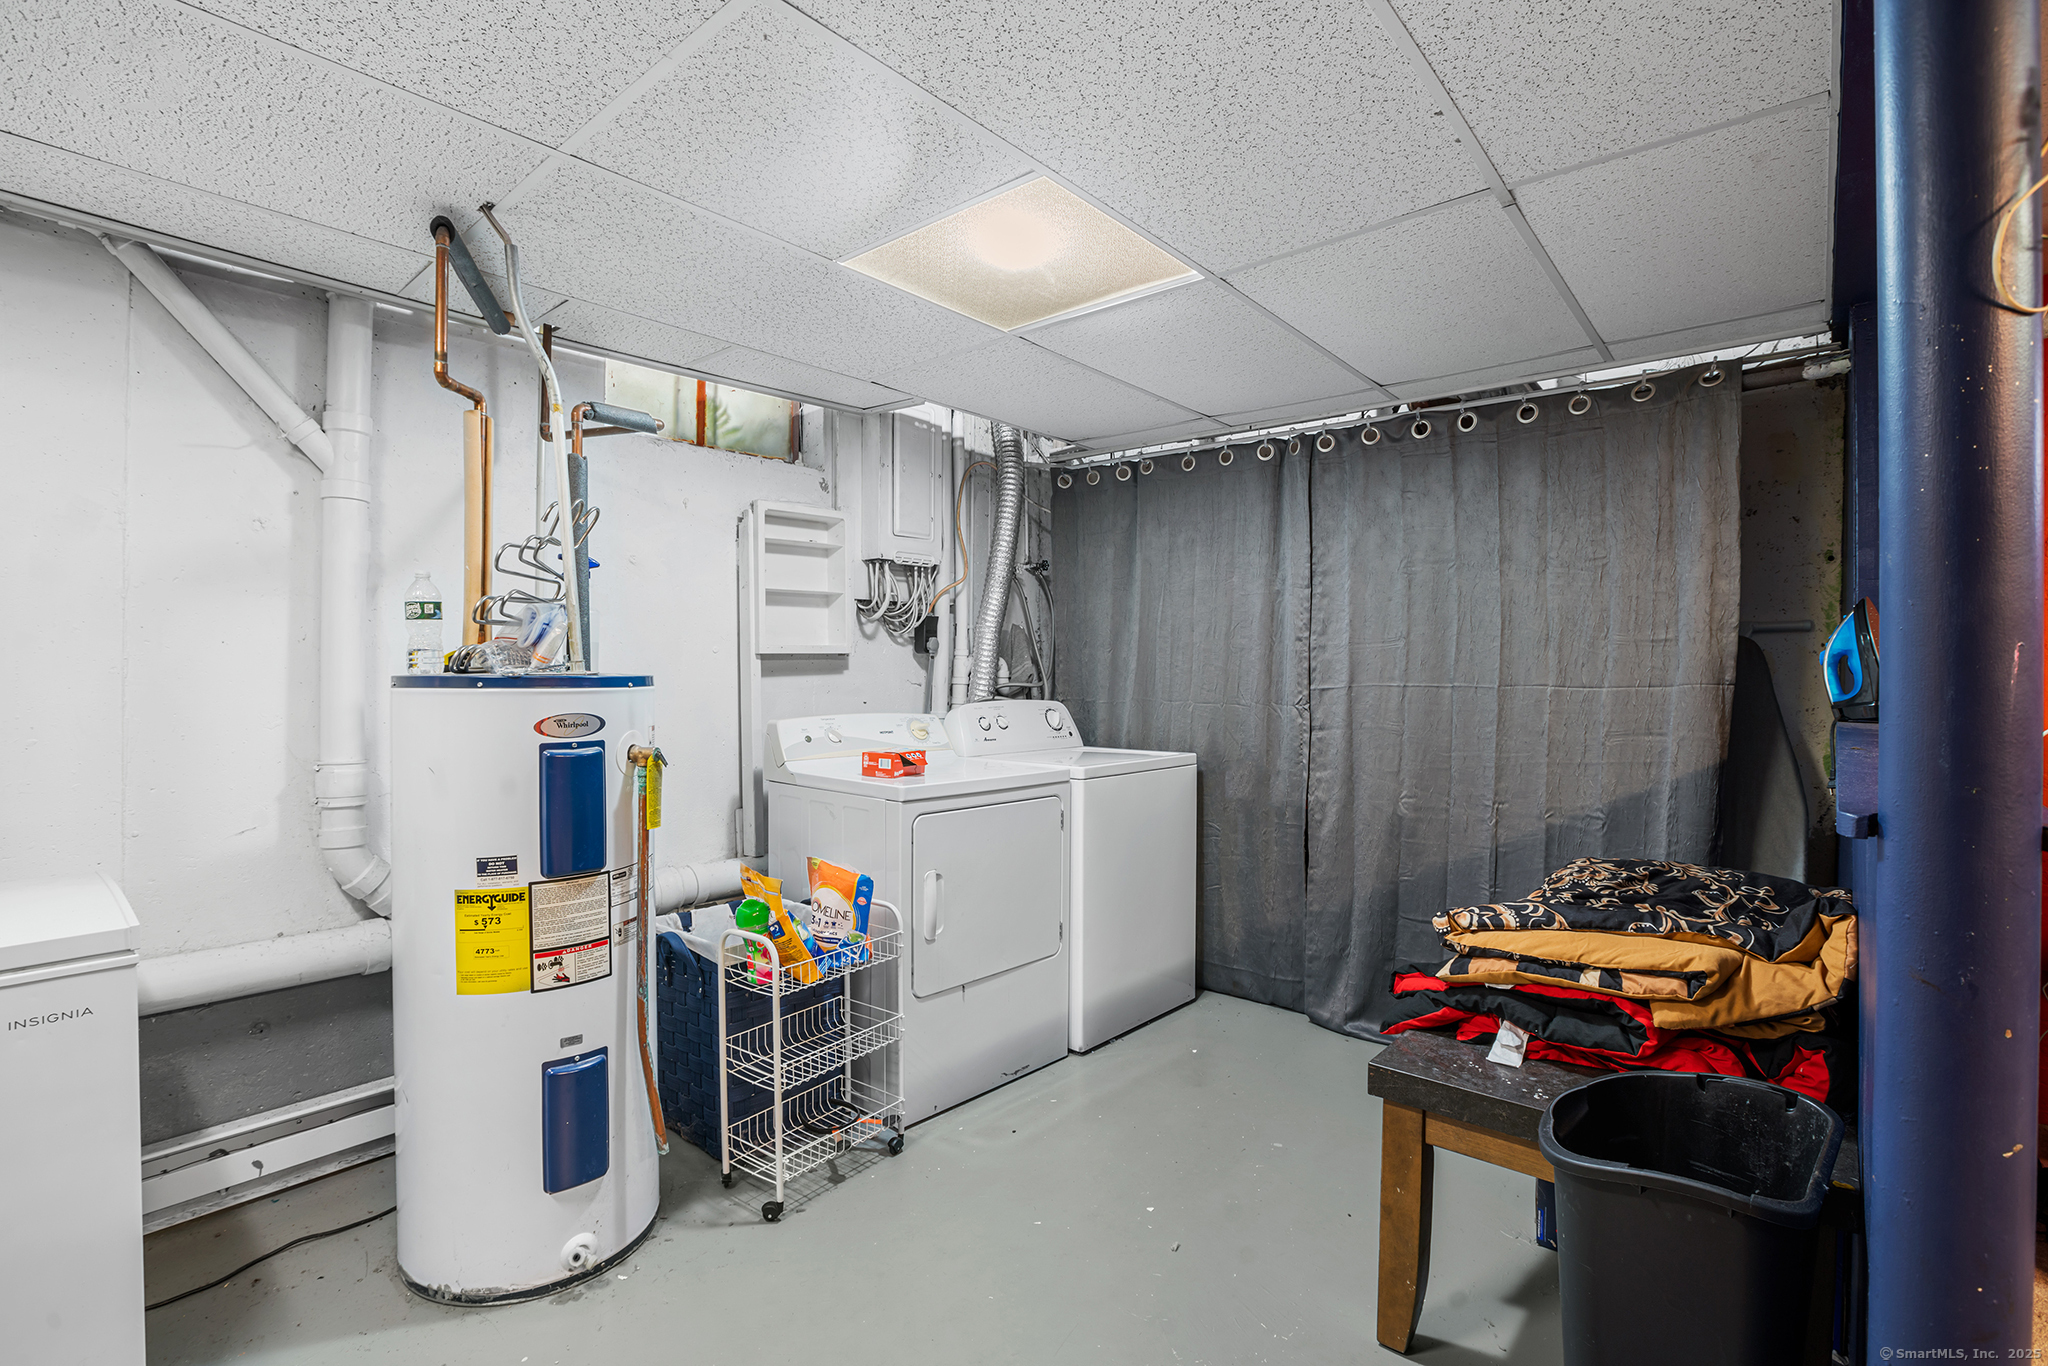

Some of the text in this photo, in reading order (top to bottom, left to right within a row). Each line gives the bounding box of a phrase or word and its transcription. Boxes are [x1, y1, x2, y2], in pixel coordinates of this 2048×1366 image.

[556, 721, 589, 729] Whirlpool
[457, 892, 526, 907] ENERGYGUIDE
[812, 901, 852, 921] OMELINE
[481, 917, 501, 926] 573
[566, 944, 593, 953] DANGER
[8, 1007, 94, 1031] INSIGNIA
